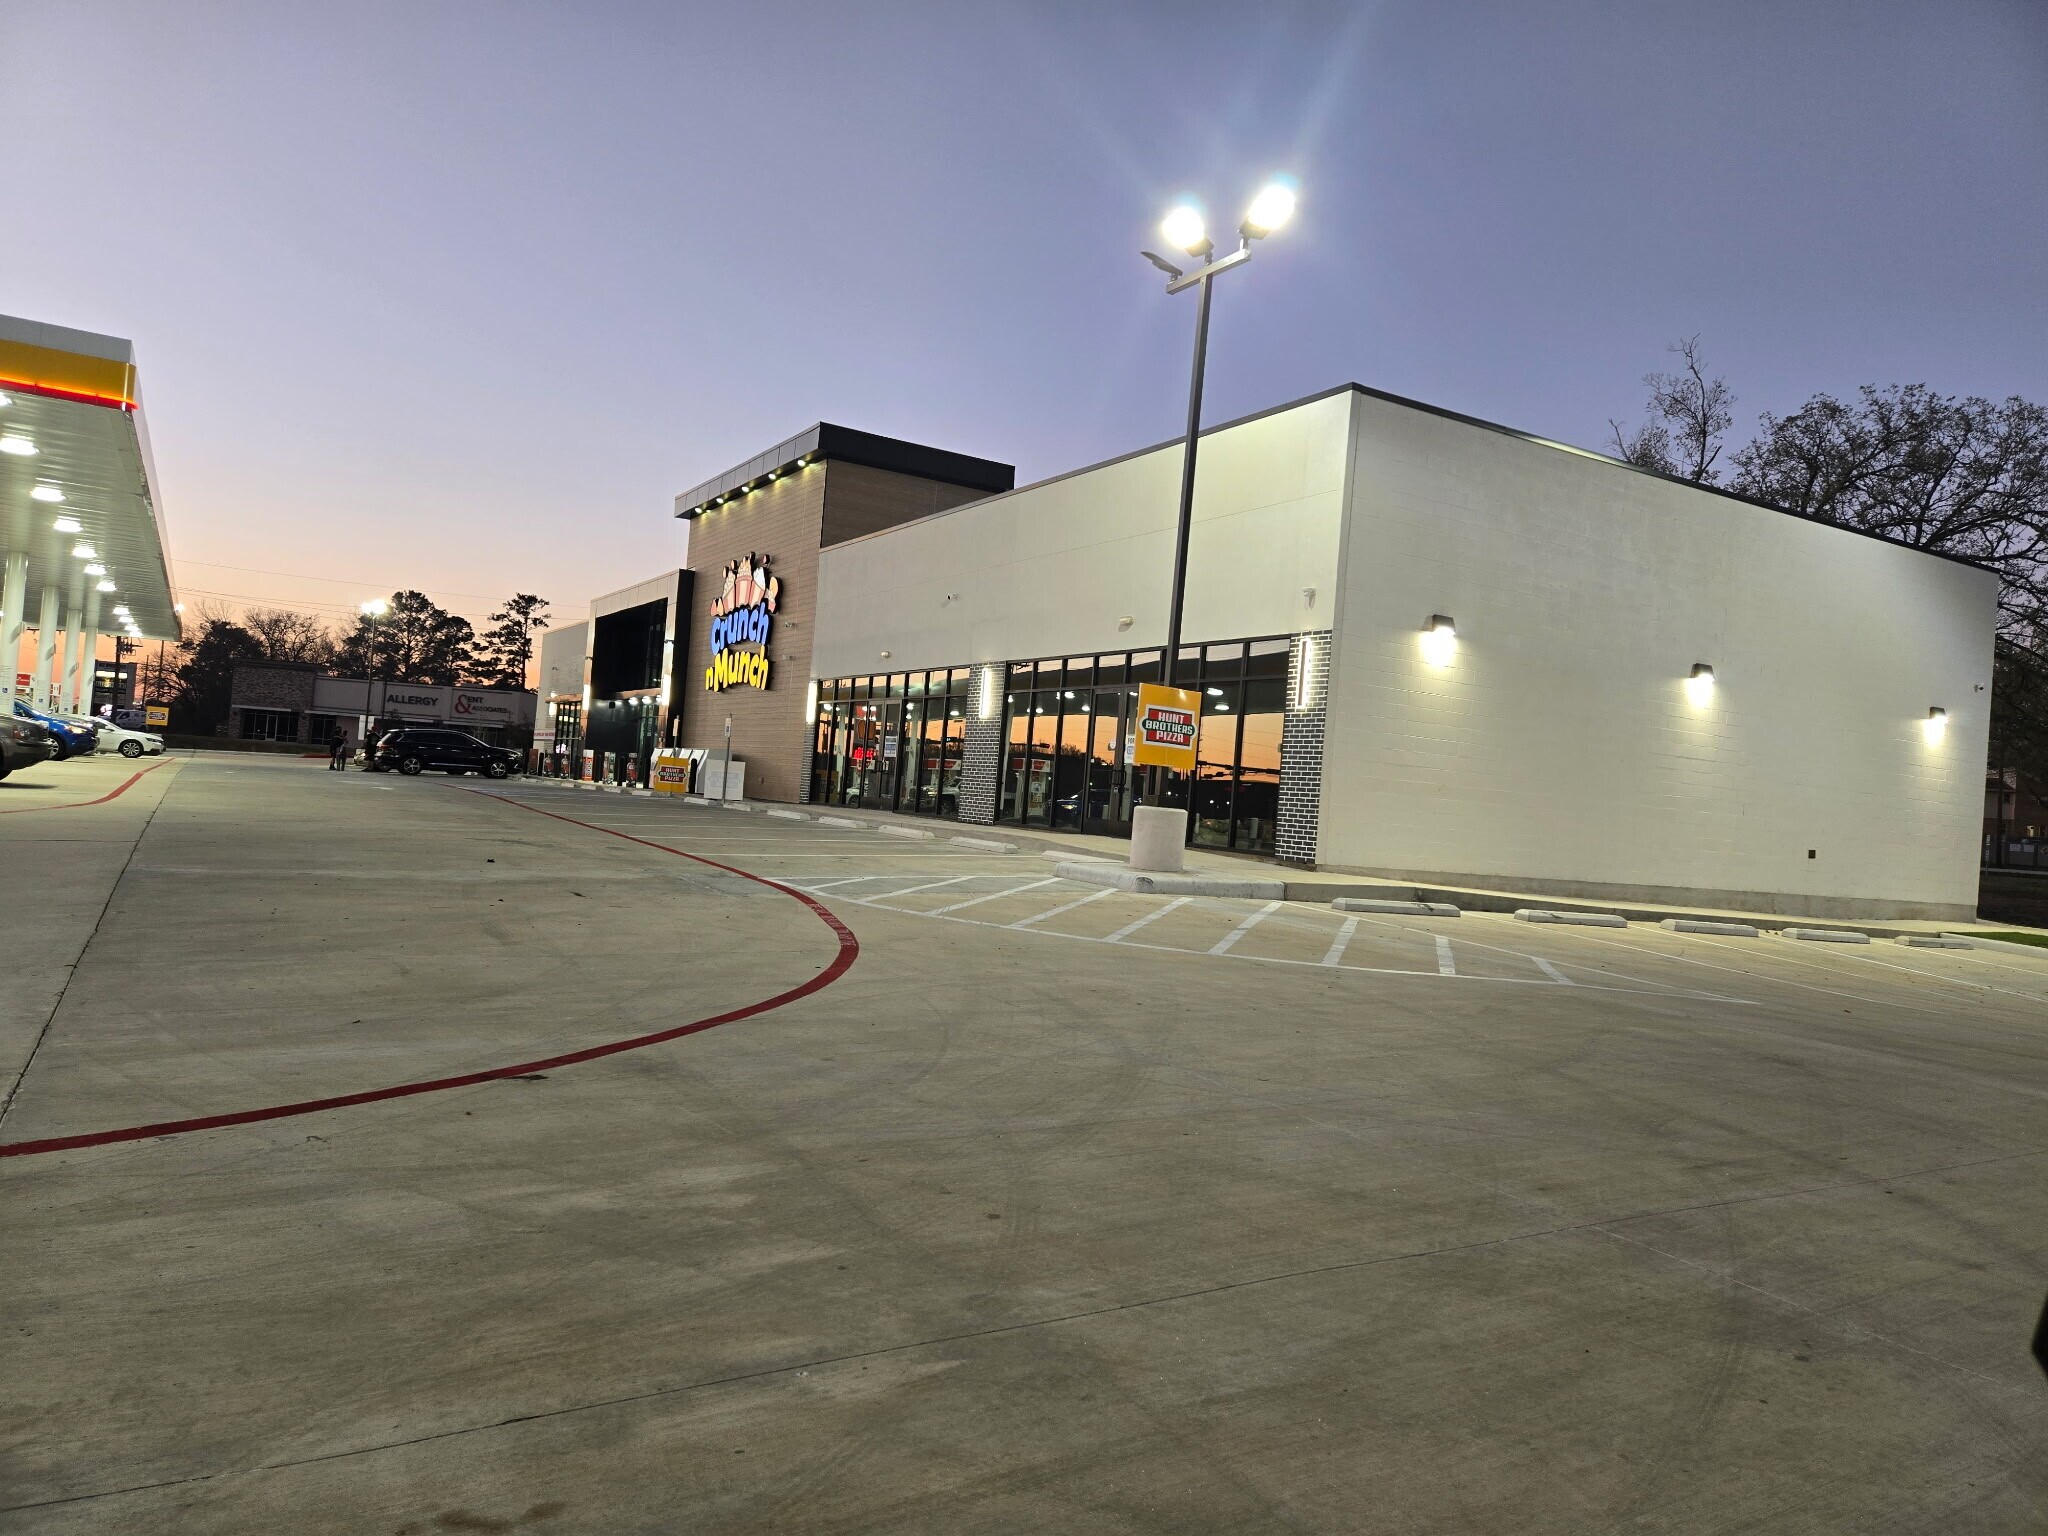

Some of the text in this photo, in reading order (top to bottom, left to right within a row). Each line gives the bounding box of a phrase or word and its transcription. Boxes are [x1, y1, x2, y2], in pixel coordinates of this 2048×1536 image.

[711, 602, 769, 656] Crunch
[714, 645, 769, 692] Munch
[386, 694, 439, 706] ALLERGY
[1158, 711, 1185, 725] HUNT
[1146, 720, 1193, 735] BROTHERS
[1156, 731, 1183, 743] PIZZA
